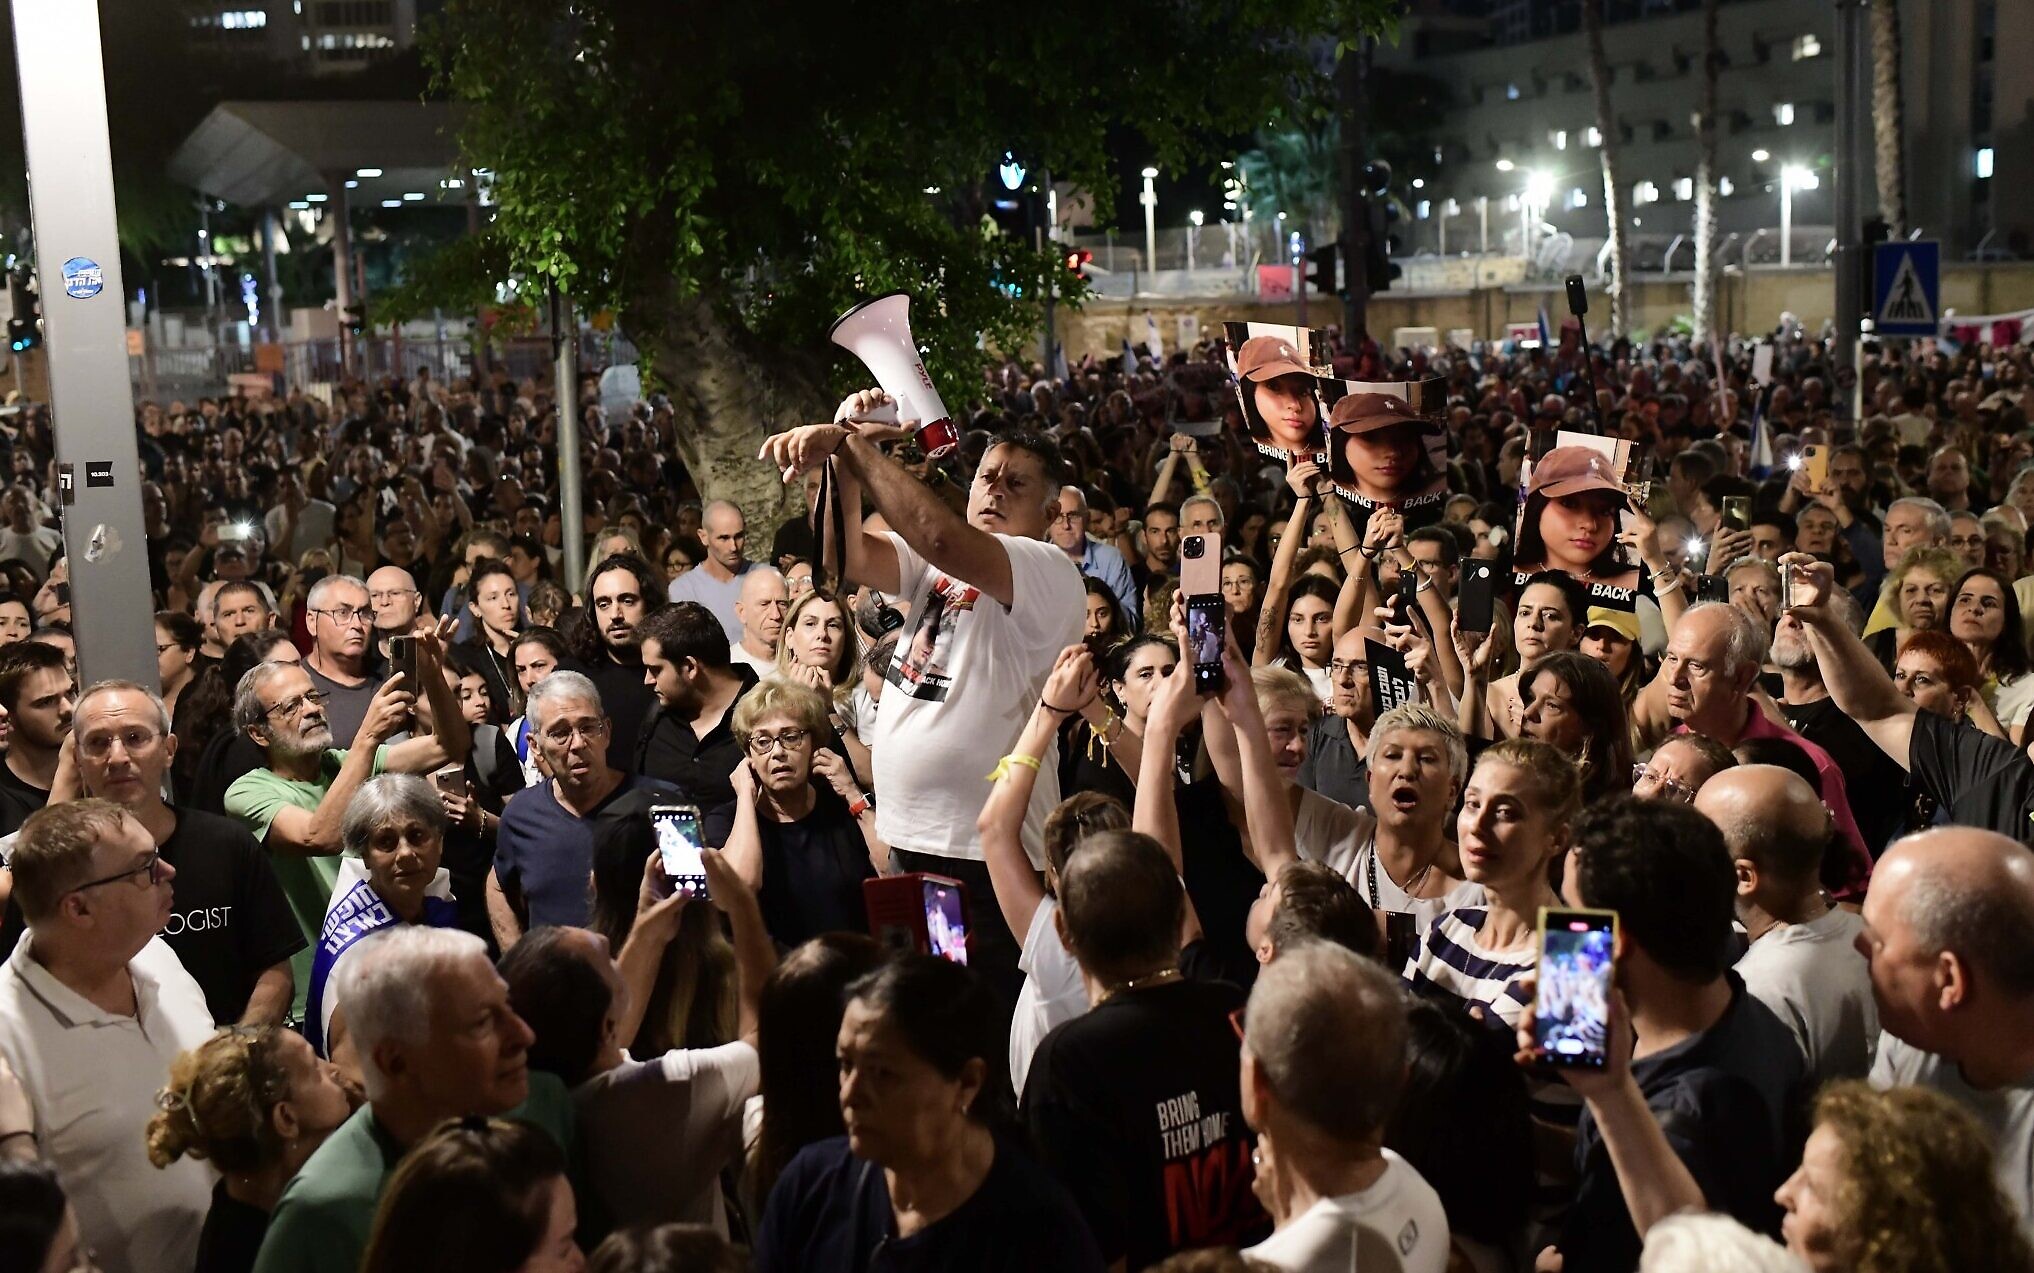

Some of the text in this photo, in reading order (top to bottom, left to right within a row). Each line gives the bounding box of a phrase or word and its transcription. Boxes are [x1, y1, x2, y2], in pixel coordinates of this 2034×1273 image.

[915, 362, 933, 390] PYLE
[1257, 442, 1291, 463] BRING
[1336, 485, 1372, 509] BRING
[1404, 491, 1442, 509] BACK
[1591, 583, 1633, 602] BACK
[157, 906, 232, 936] OGIST
[325, 902, 393, 955] בארצנו
[1156, 1090, 1201, 1131] BRING
[1162, 1124, 1201, 1160] THEM
